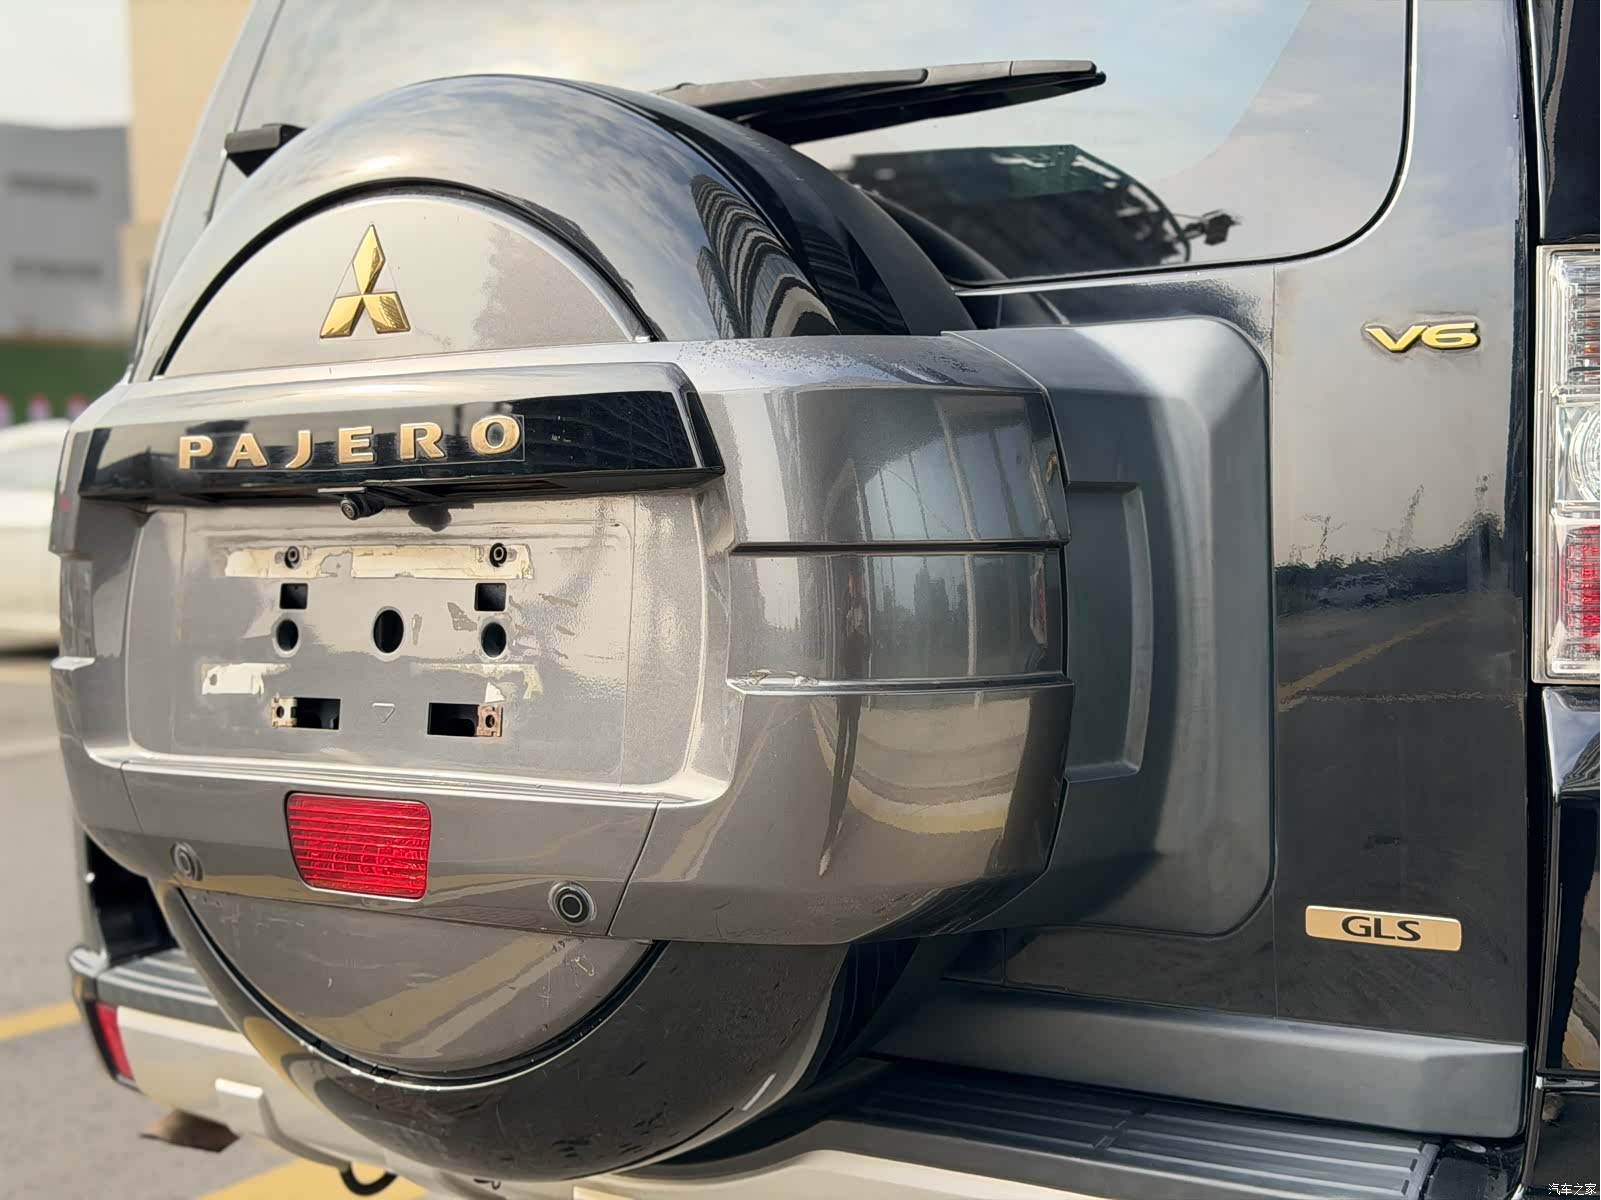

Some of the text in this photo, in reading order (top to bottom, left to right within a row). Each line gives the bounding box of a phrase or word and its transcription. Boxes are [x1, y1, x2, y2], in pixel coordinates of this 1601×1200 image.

[1365, 321, 1479, 353] V6
[178, 414, 522, 470] PAJERO
[1341, 915, 1421, 942] GLS
